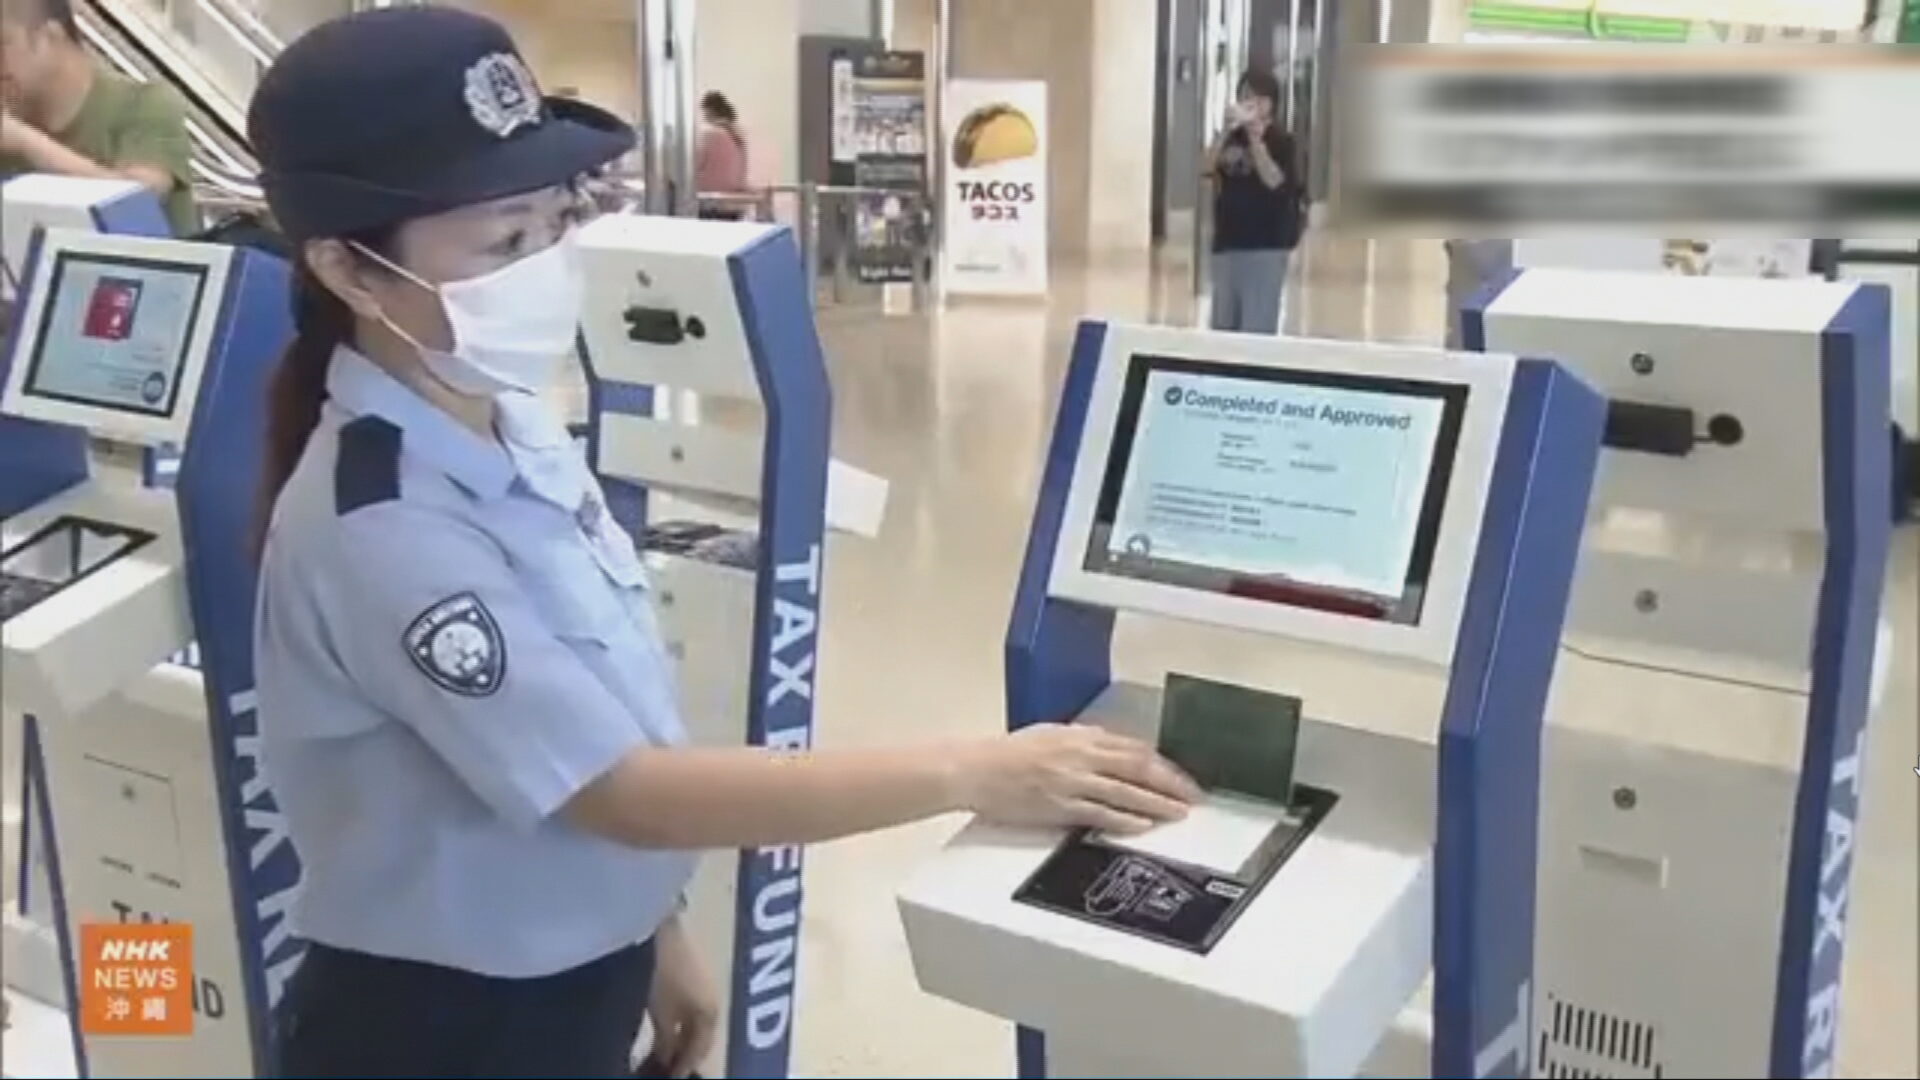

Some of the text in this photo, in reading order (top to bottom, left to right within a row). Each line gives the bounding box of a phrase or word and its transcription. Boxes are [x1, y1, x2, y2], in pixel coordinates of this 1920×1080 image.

[957, 182, 1034, 202] TACOS
[1184, 389, 1277, 416] Completed
[1281, 402, 1316, 420] and
[1320, 404, 1412, 430] Approved
[768, 544, 820, 708] TAX
[1811, 729, 1864, 962] TAX
